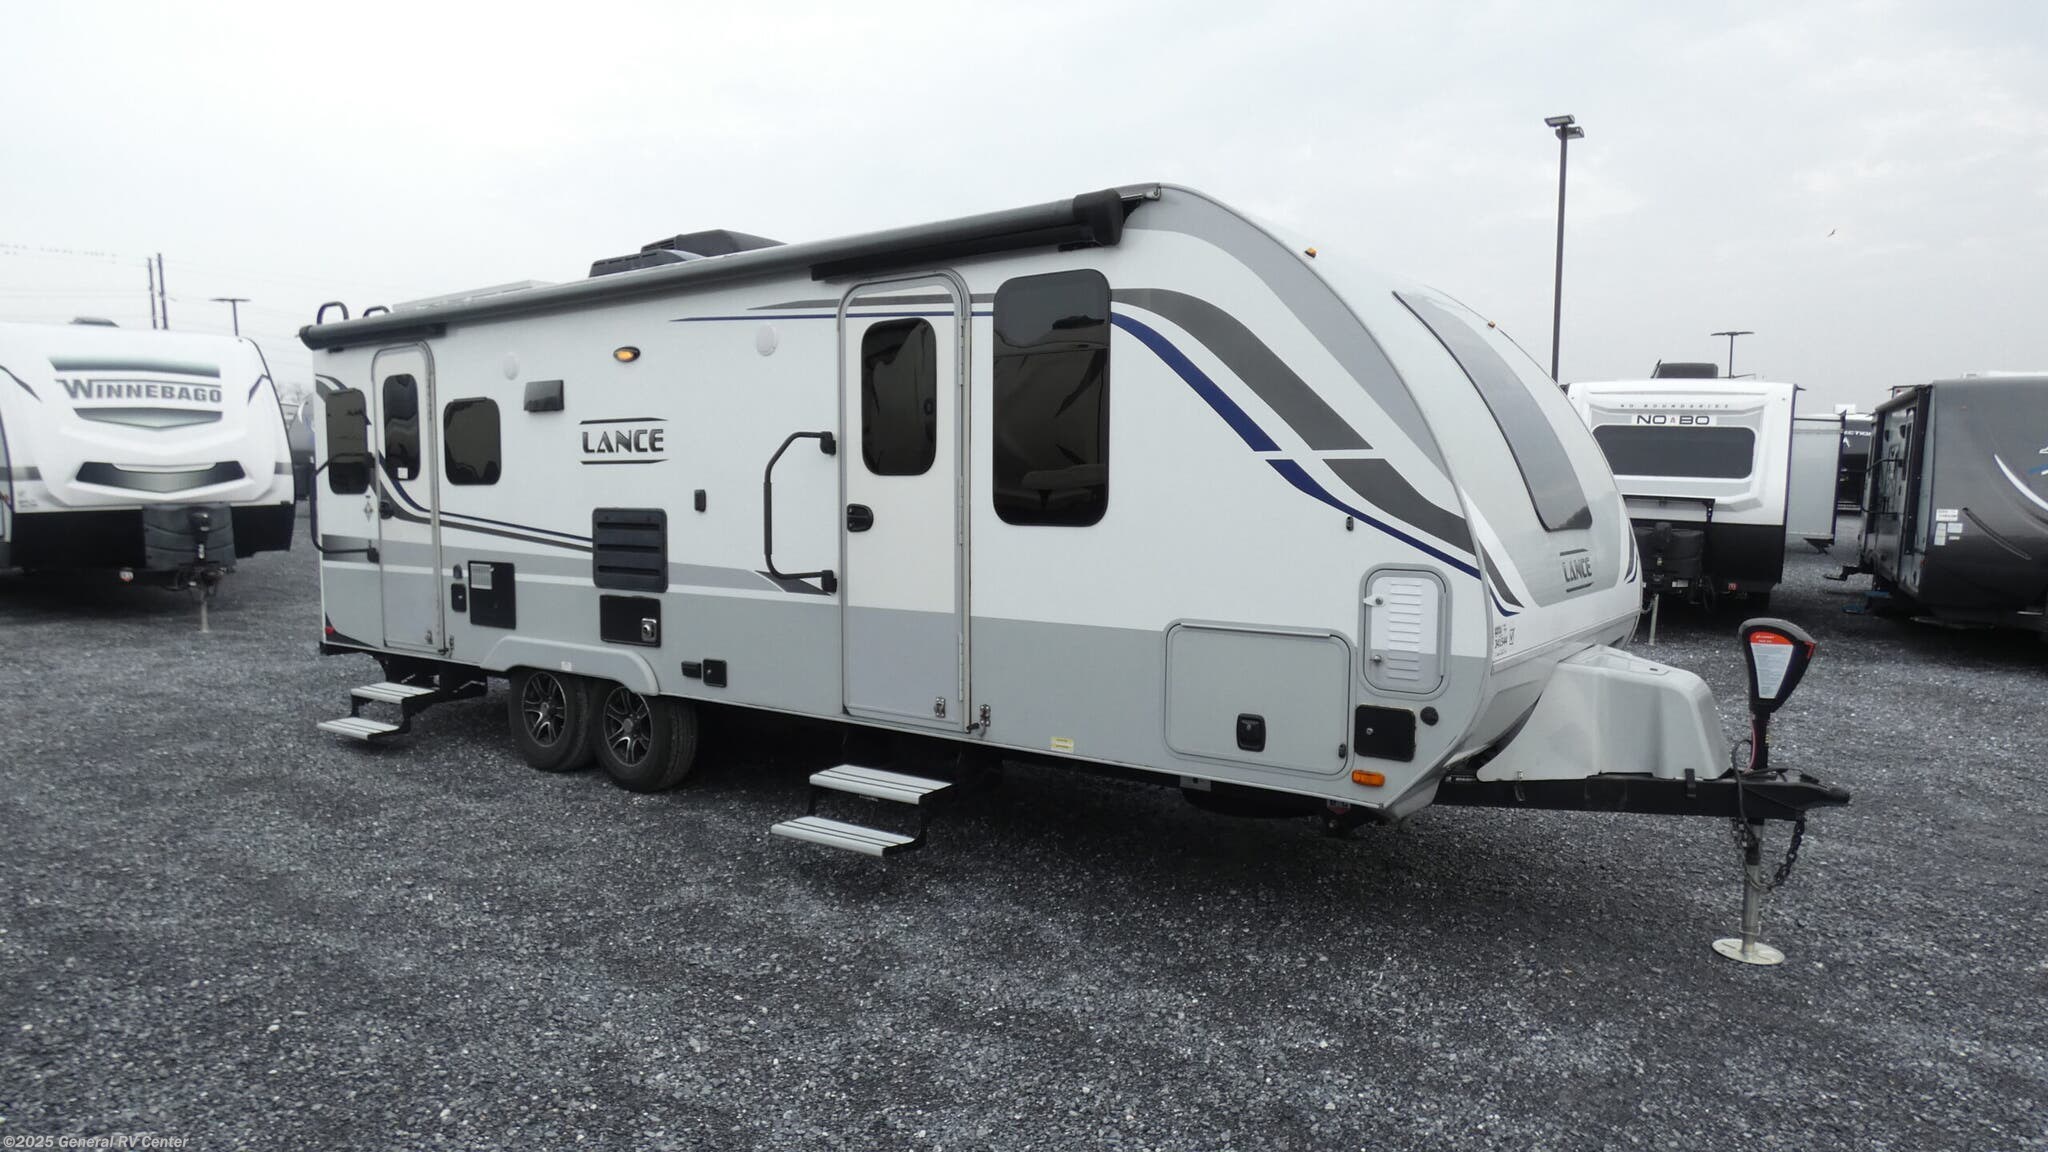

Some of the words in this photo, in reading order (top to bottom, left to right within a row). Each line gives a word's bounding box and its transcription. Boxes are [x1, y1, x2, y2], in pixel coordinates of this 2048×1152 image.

[58, 379, 222, 403] WINNEBAGO
[1637, 415, 1667, 425] NO
[582, 428, 664, 453] LANCE
[1562, 557, 1593, 582] LANCE
